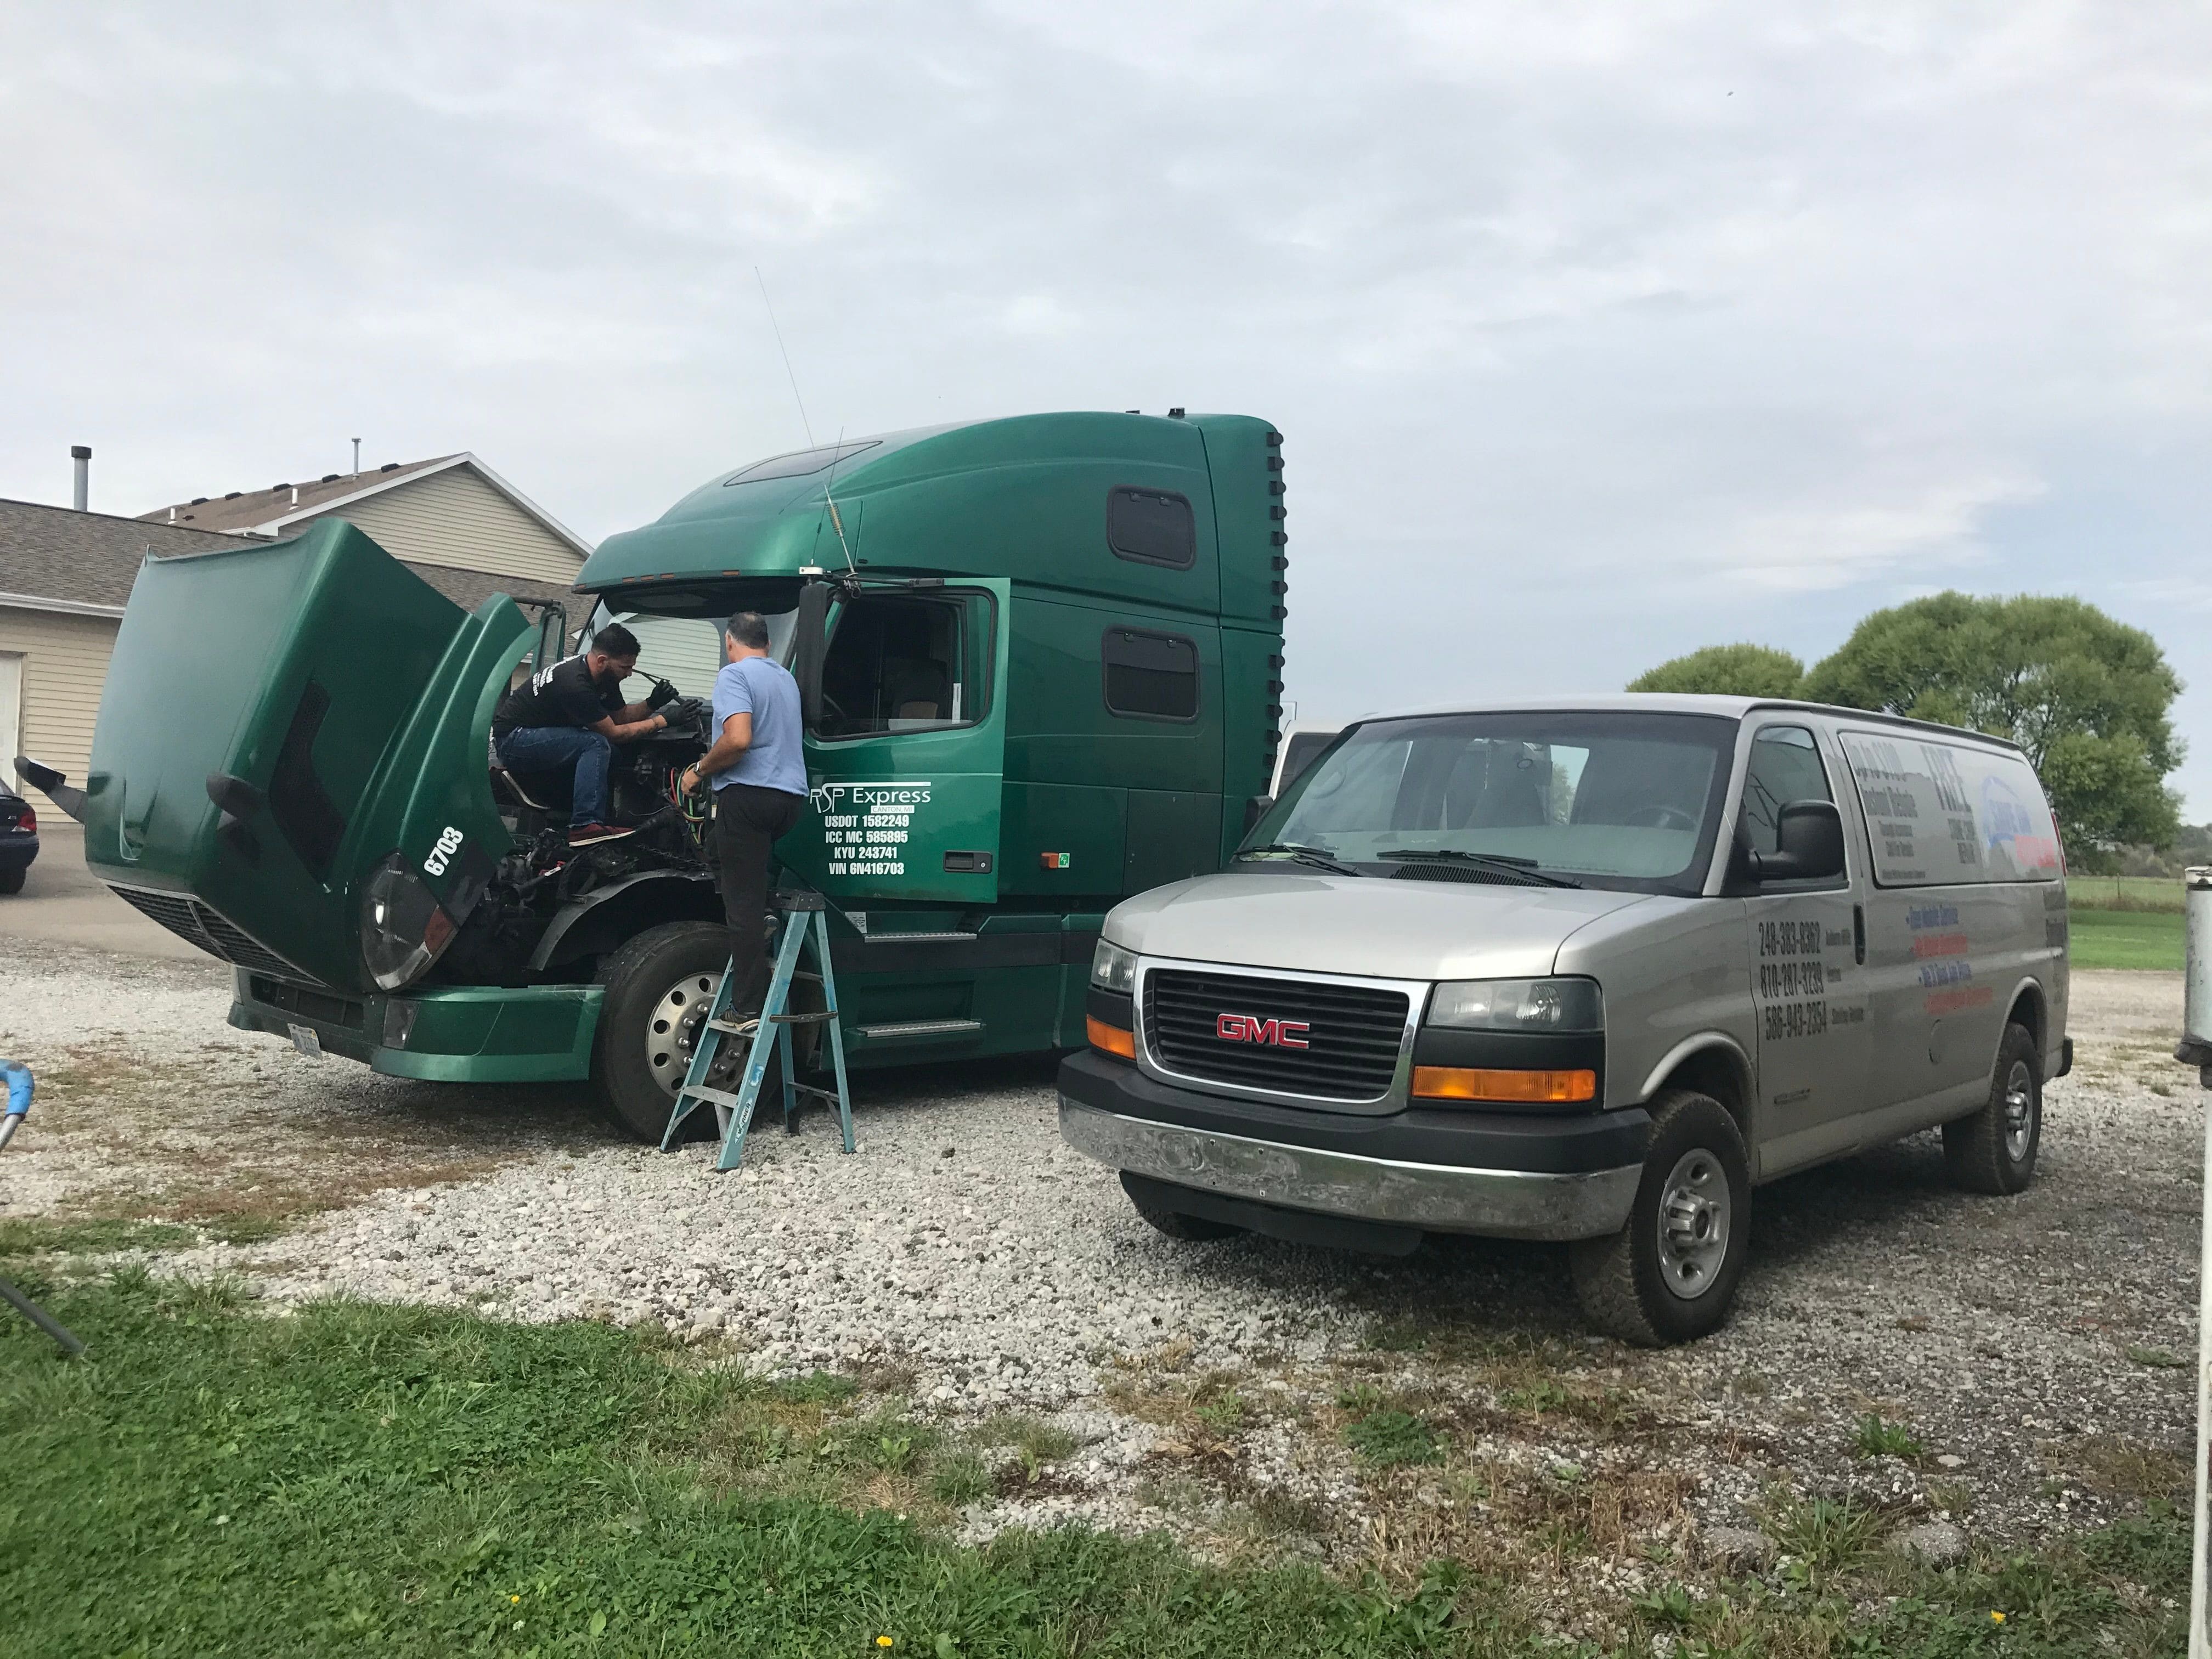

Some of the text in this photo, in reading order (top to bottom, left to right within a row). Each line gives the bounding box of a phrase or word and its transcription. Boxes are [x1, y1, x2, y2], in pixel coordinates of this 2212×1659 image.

[810, 783, 931, 813] RSP Express
[825, 815, 910, 827] USDOT 1582249
[826, 831, 908, 843] ICC MC 585895
[424, 826, 464, 876] 6703
[834, 847, 897, 859] KYU 243741
[828, 862, 904, 874] VIN 6N416703
[1217, 1013, 1310, 1049] GMC
